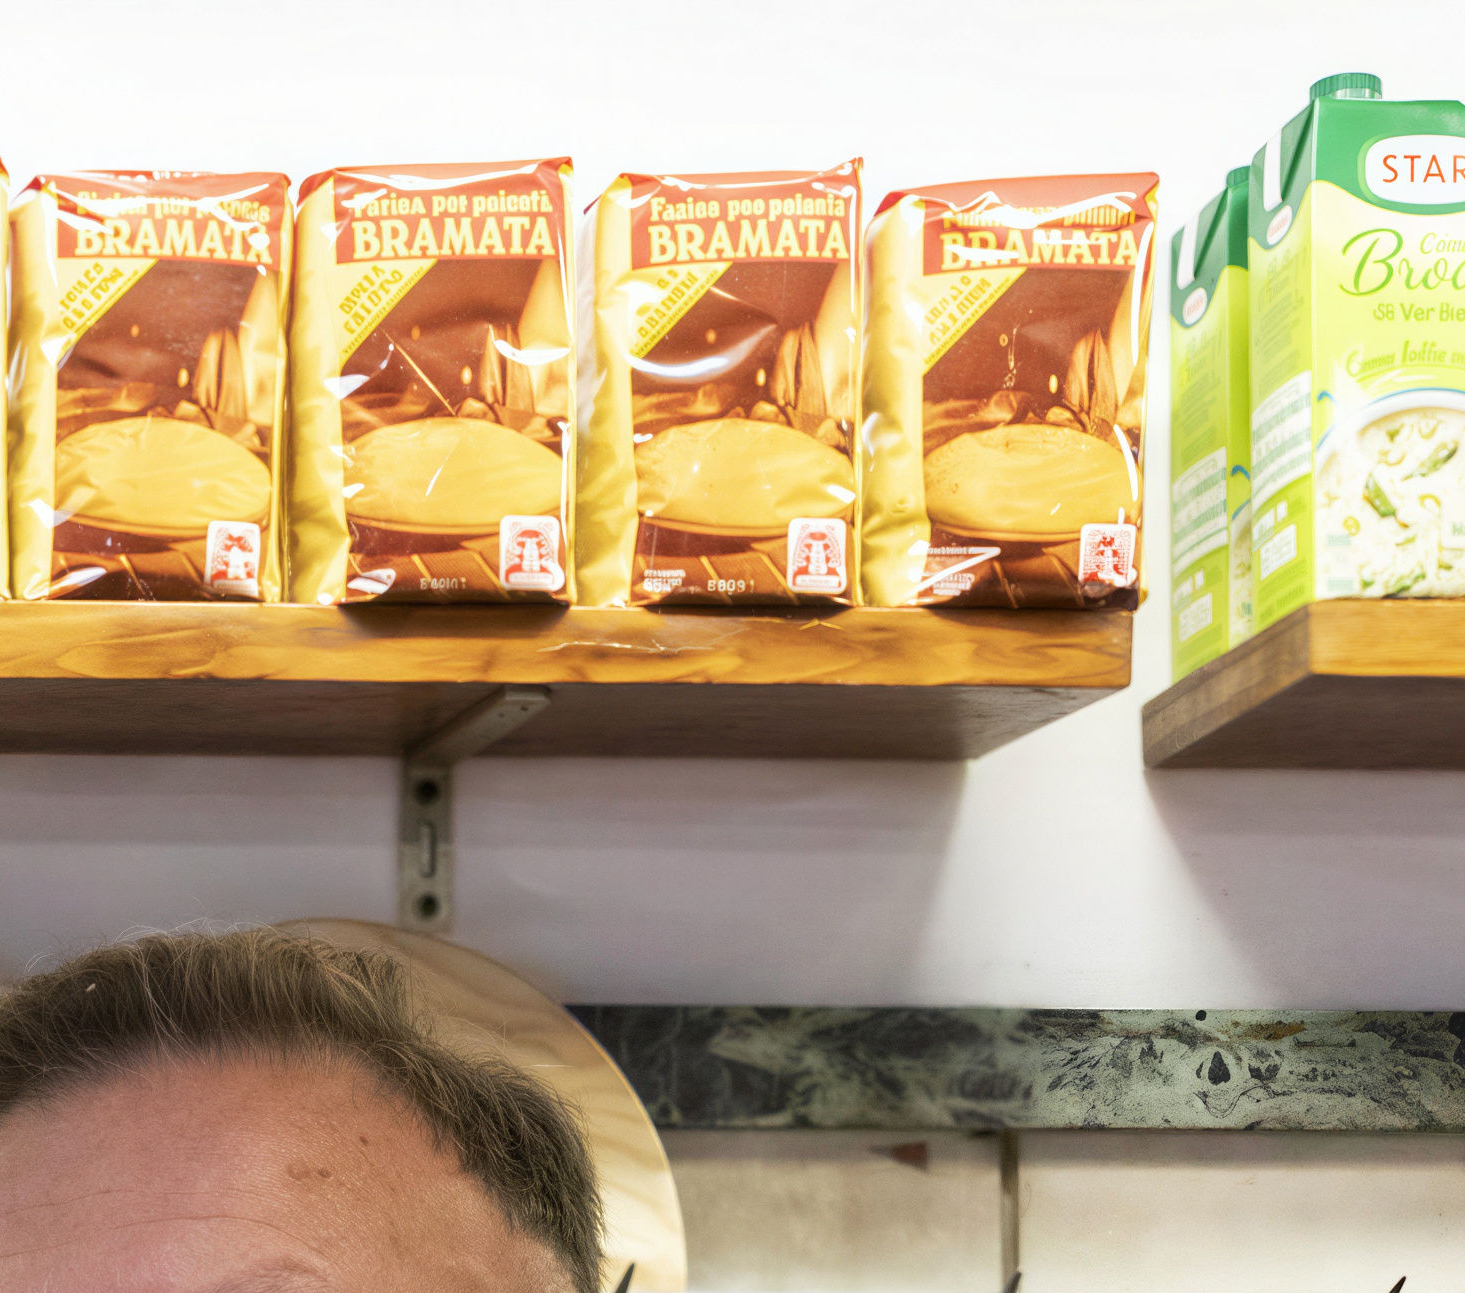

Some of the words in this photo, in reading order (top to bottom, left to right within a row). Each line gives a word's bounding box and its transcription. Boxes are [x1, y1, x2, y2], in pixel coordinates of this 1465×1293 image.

[74, 217, 273, 265] BRAMATA
[351, 216, 556, 260] BRAMATA
[647, 219, 849, 264] BRAMATA
[939, 229, 1138, 271] BRAMATA
